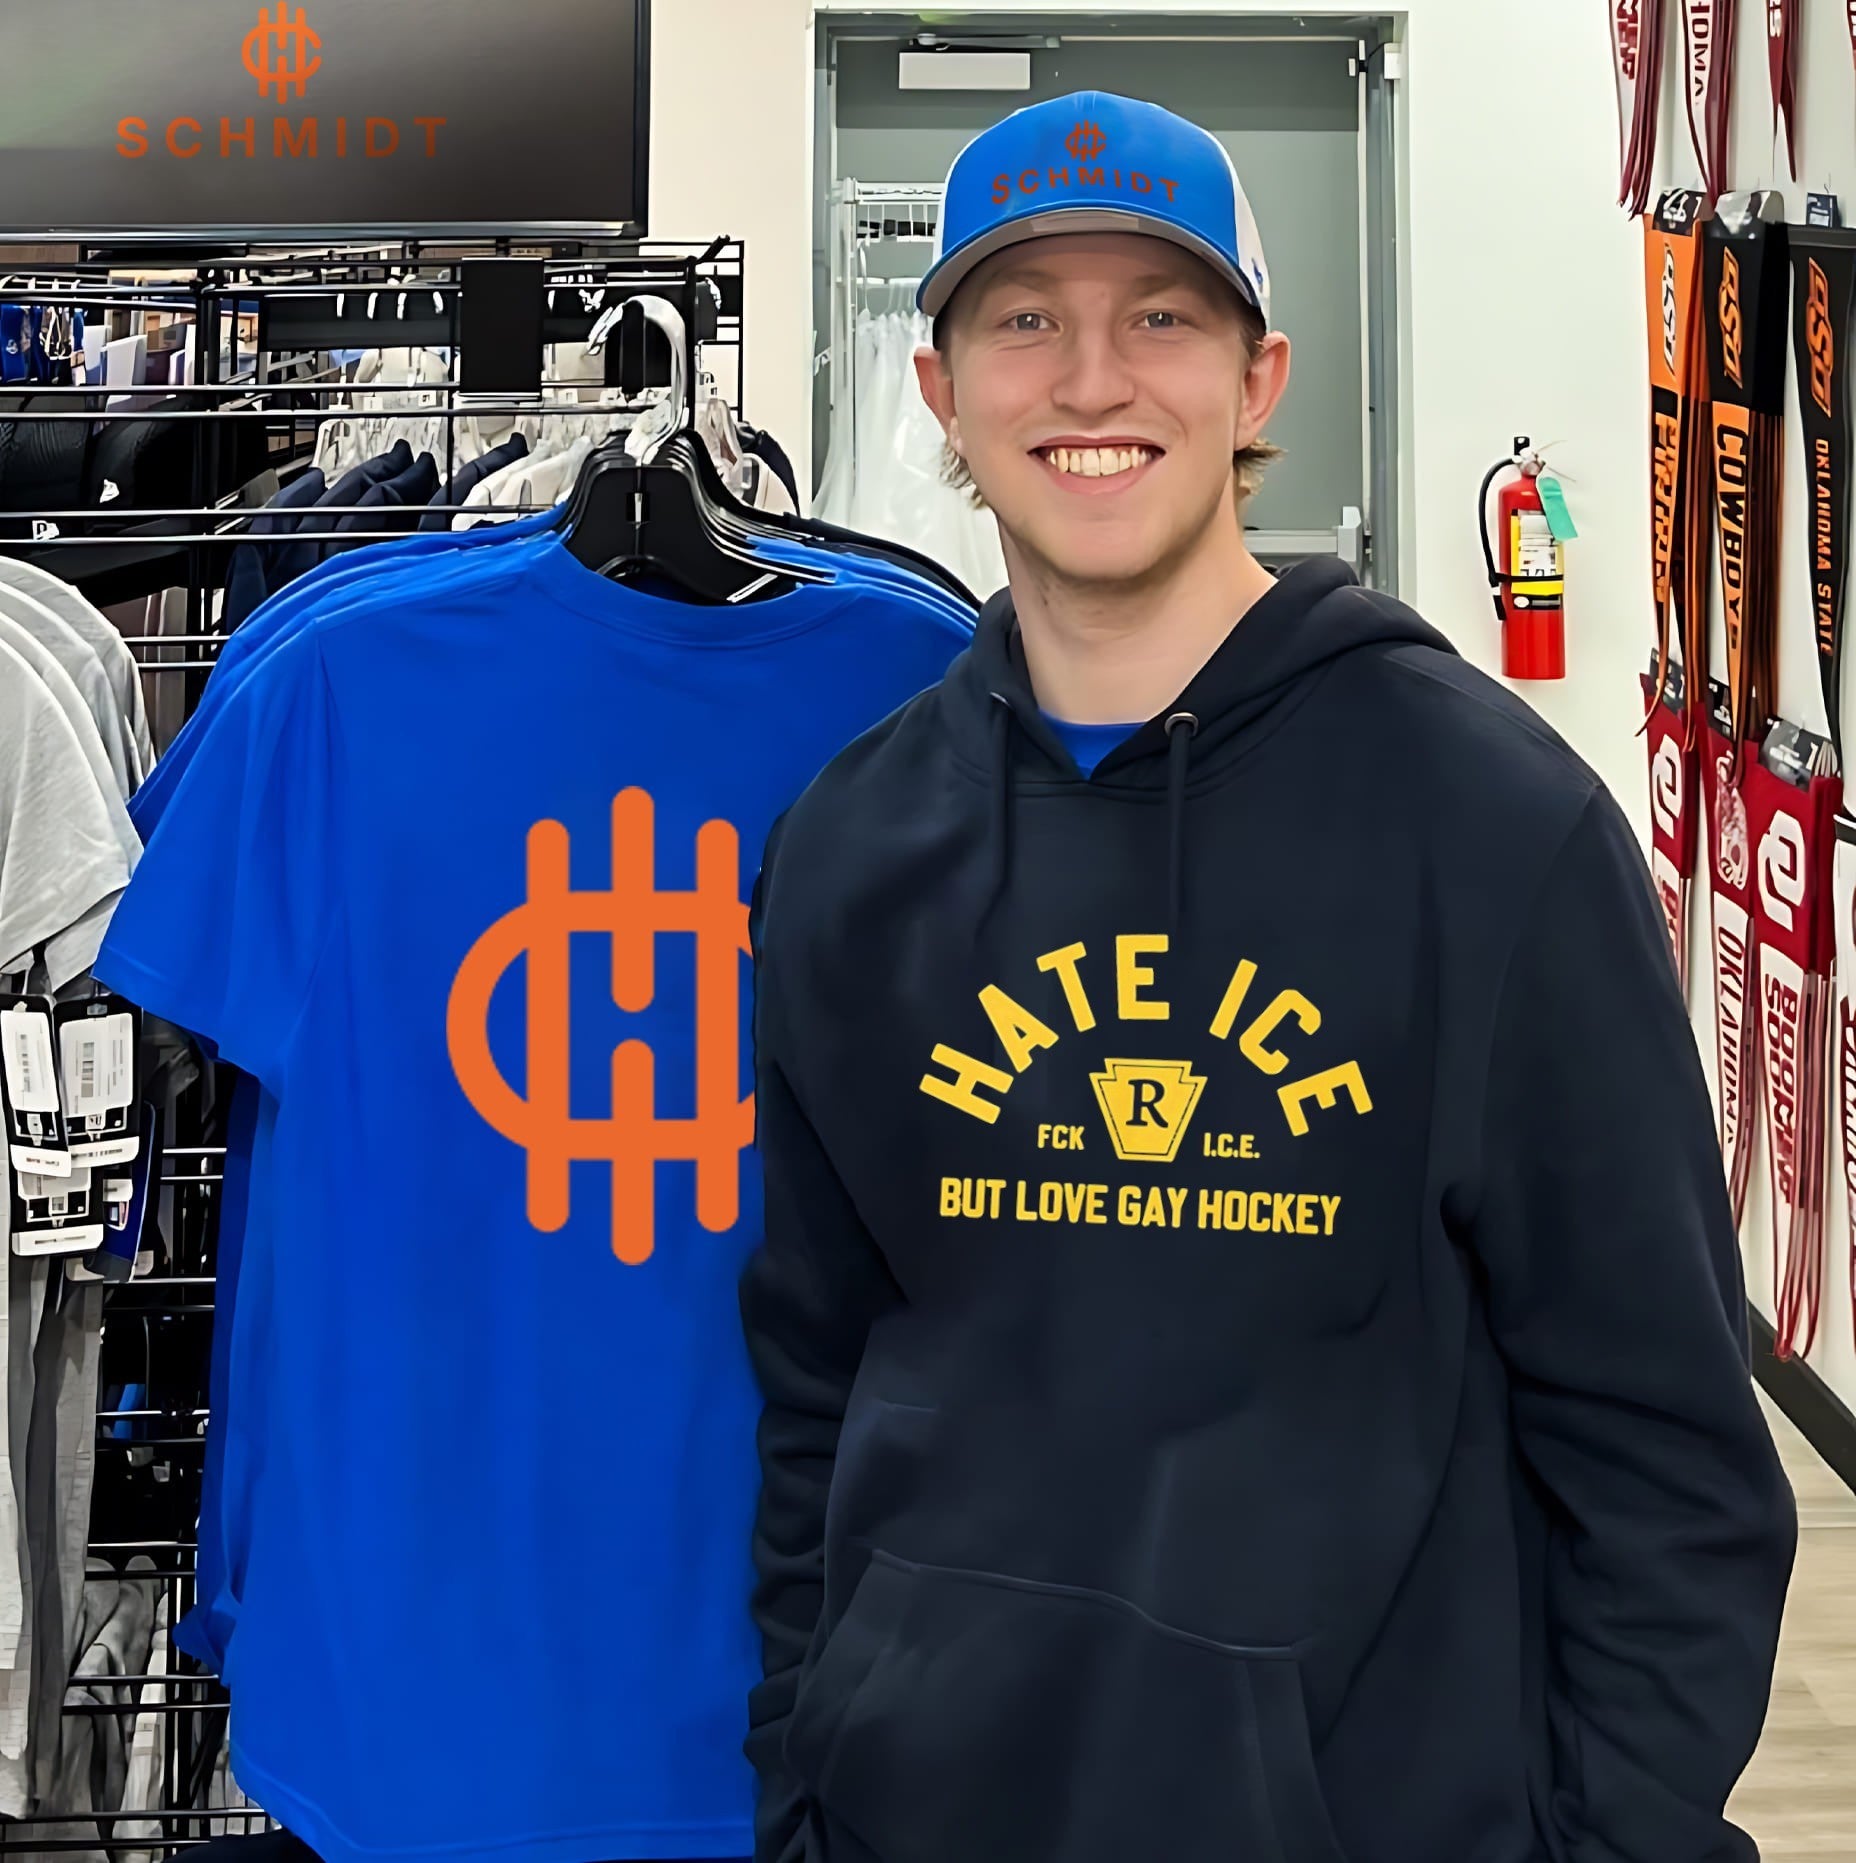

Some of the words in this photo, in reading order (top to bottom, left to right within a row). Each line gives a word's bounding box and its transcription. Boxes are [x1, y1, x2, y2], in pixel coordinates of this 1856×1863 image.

[115, 116, 448, 159] SCHMIDT
[991, 167, 1180, 205] SCHMIDT
[1815, 438, 1832, 570] OKLAHOMA
[919, 934, 1170, 1124] HATE
[1209, 958, 1373, 1137] ICE
[1126, 1079, 1169, 1129] R
[1037, 1123, 1085, 1150] FCK
[1203, 1132, 1261, 1159] I.C.E.
[939, 1177, 1007, 1219] BUT
[1015, 1180, 1109, 1224] LOVE
[1117, 1185, 1188, 1229] GAY
[1197, 1188, 1341, 1236] HOCKEY
